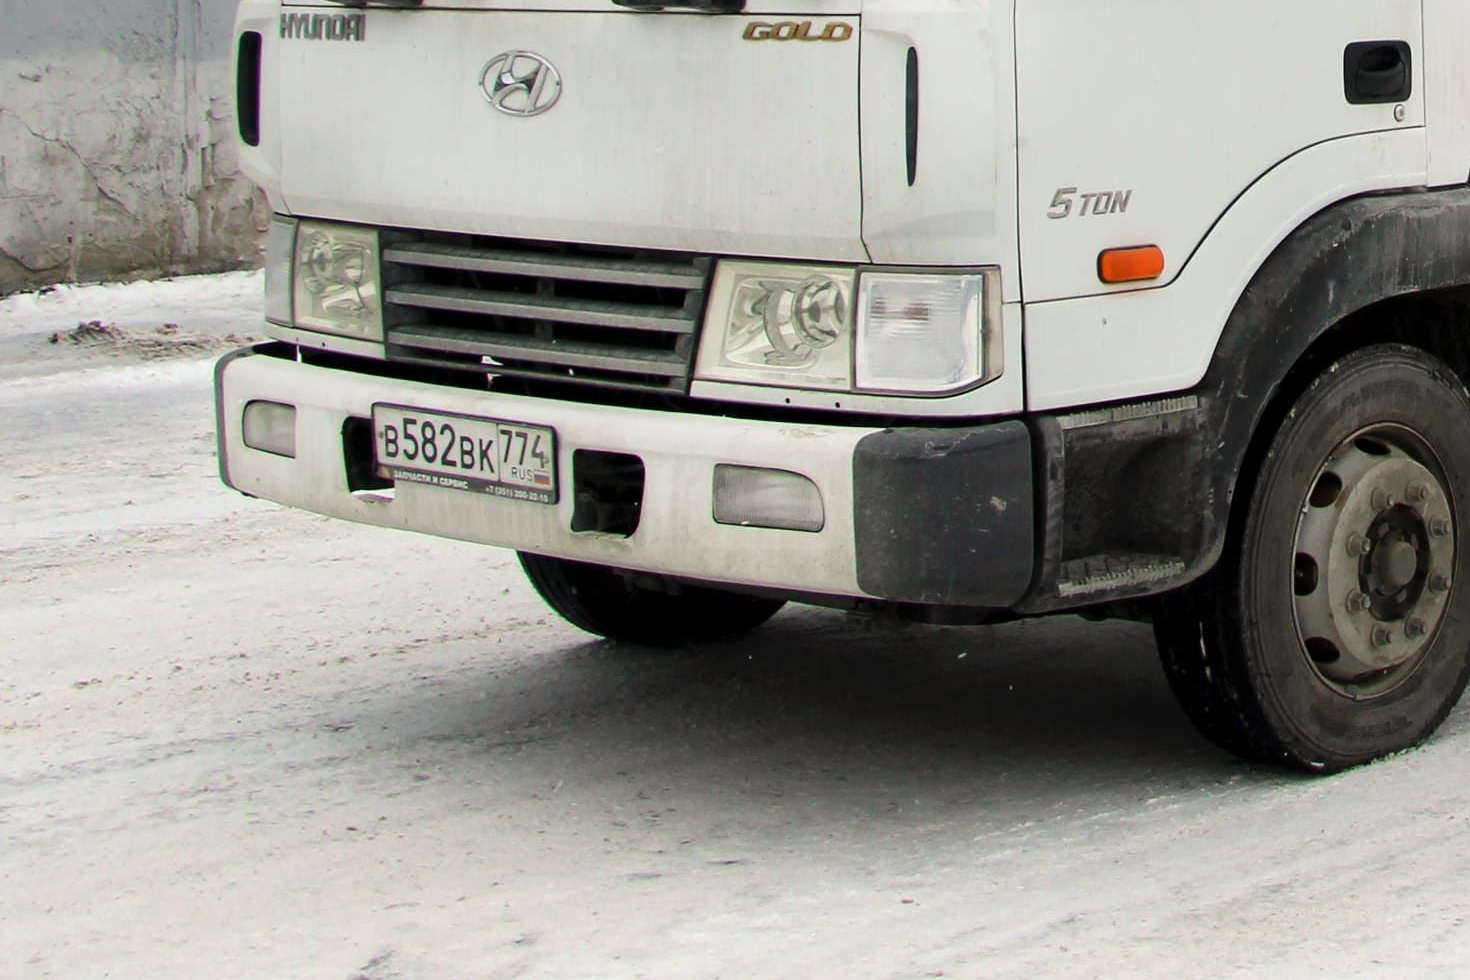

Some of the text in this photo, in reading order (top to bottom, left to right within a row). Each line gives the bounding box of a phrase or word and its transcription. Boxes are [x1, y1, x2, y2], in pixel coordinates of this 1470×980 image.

[280, 13, 366, 41] HYUNDAI
[742, 21, 853, 42] GOLD
[1046, 187, 1132, 219] 5 TON
[439, 476, 469, 490] СЕРВИС
[511, 466, 534, 481] RUS
